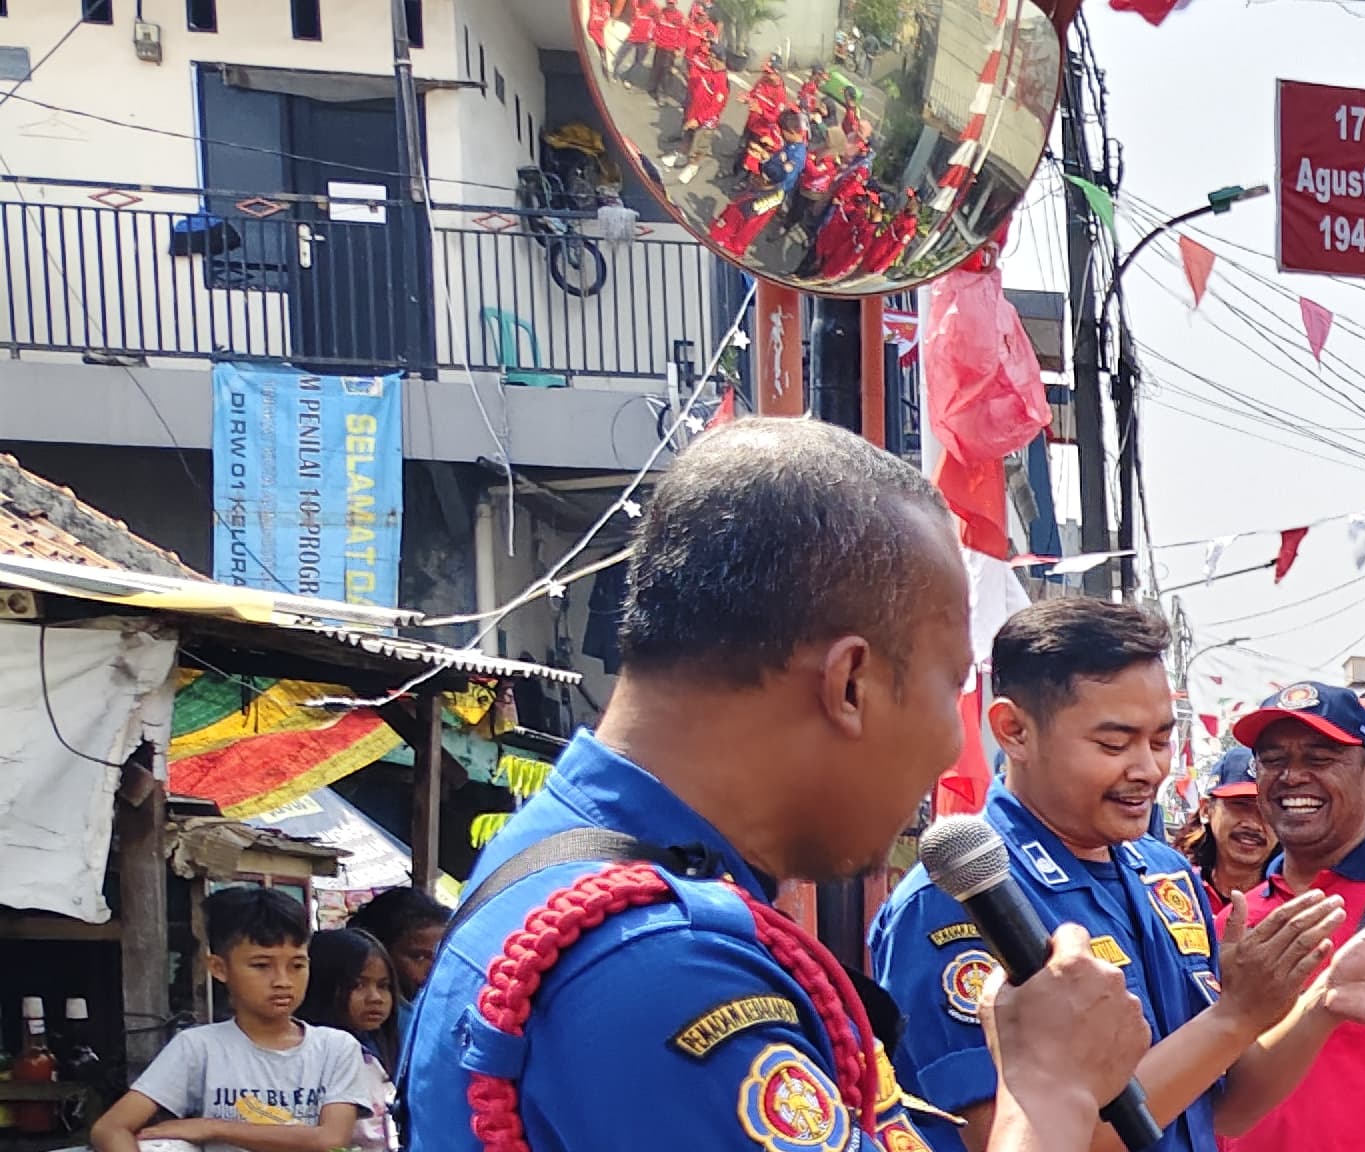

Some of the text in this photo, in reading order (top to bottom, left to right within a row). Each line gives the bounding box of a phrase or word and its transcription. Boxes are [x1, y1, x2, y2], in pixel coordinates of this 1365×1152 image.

[230, 392, 247, 415] DI
[299, 399, 321, 480] PENILAI
[345, 413, 377, 565] SELAMAT
